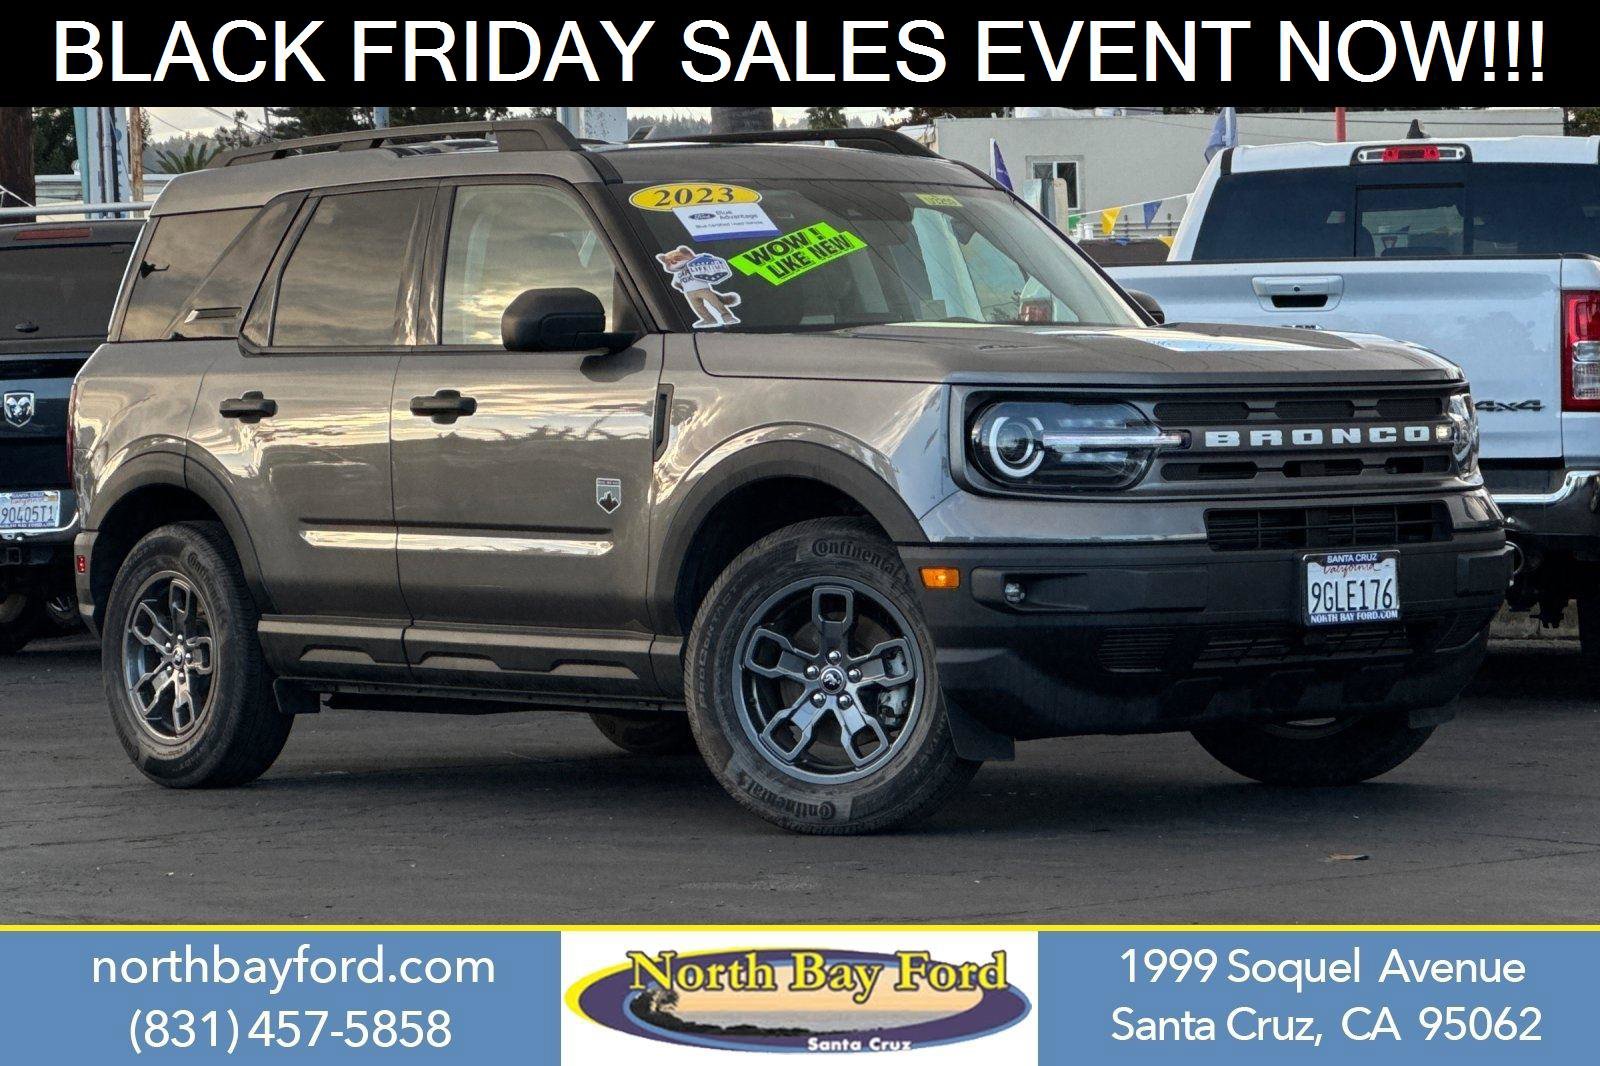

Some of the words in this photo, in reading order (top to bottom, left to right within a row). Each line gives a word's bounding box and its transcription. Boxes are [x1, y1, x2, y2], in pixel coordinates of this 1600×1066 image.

[654, 187, 734, 206] 2023
[742, 233, 810, 266] WOW
[765, 252, 815, 278] LIKE
[810, 236, 850, 261] NEW
[1474, 399, 1546, 412] 4x4
[1205, 426, 1430, 447] BRONCO
[1, 505, 54, 525] 90405T1
[1327, 554, 1354, 563] SANTA
[1355, 553, 1378, 561] CRUZ
[1311, 578, 1393, 613] 9GLE176
[1310, 613, 1338, 624] NORTH
[1340, 612, 1356, 622] BAY
[1356, 610, 1398, 621] FORD.COM
